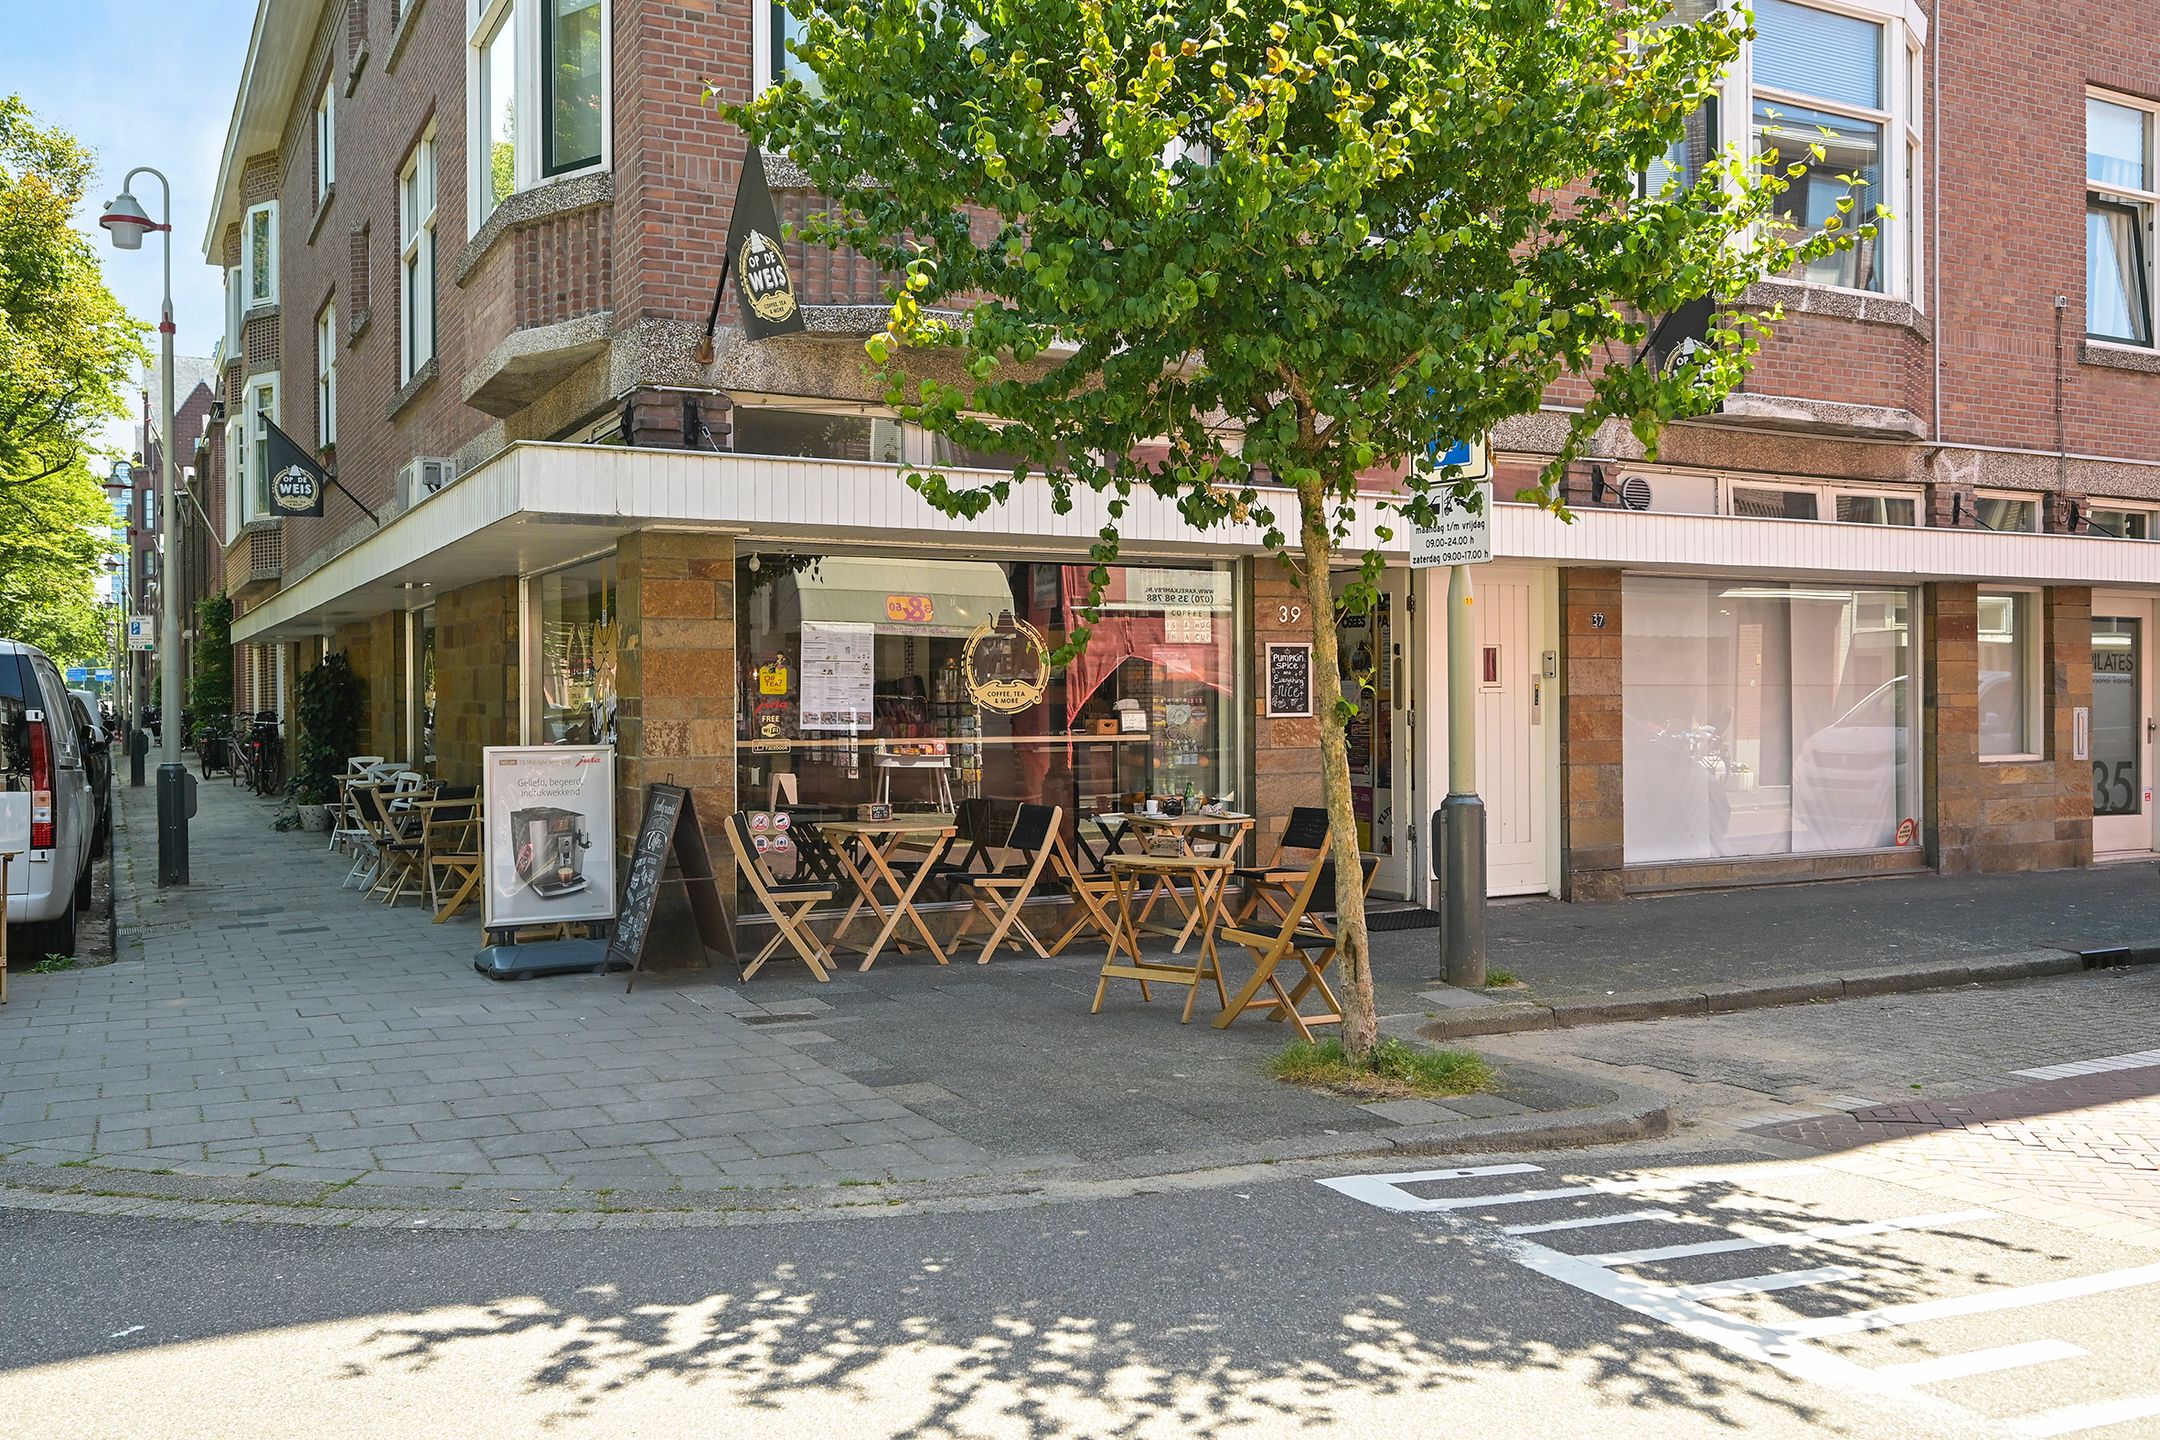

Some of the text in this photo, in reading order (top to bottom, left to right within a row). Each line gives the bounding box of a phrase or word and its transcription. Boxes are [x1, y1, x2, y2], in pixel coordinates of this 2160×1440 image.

[748, 251, 776, 268] OP DE
[748, 264, 787, 293] WEIS
[279, 483, 312, 495] WEIS
[1447, 521, 1460, 532] t/m
[1462, 520, 1485, 532] vrijdag
[1425, 535, 1475, 548] 09.00-24.00 h
[1412, 550, 1489, 565] zaterdag 09.00-17.00 h
[1171, 610, 1203, 618] COFFEE
[1278, 605, 1301, 624] 39
[1592, 613, 1604, 627] 37
[2092, 653, 2133, 671] ILATES
[575, 755, 601, 767] jura
[517, 778, 548, 788] Geliefd,
[2092, 760, 2133, 812] 35
[521, 788, 581, 798] indrukwekkend
